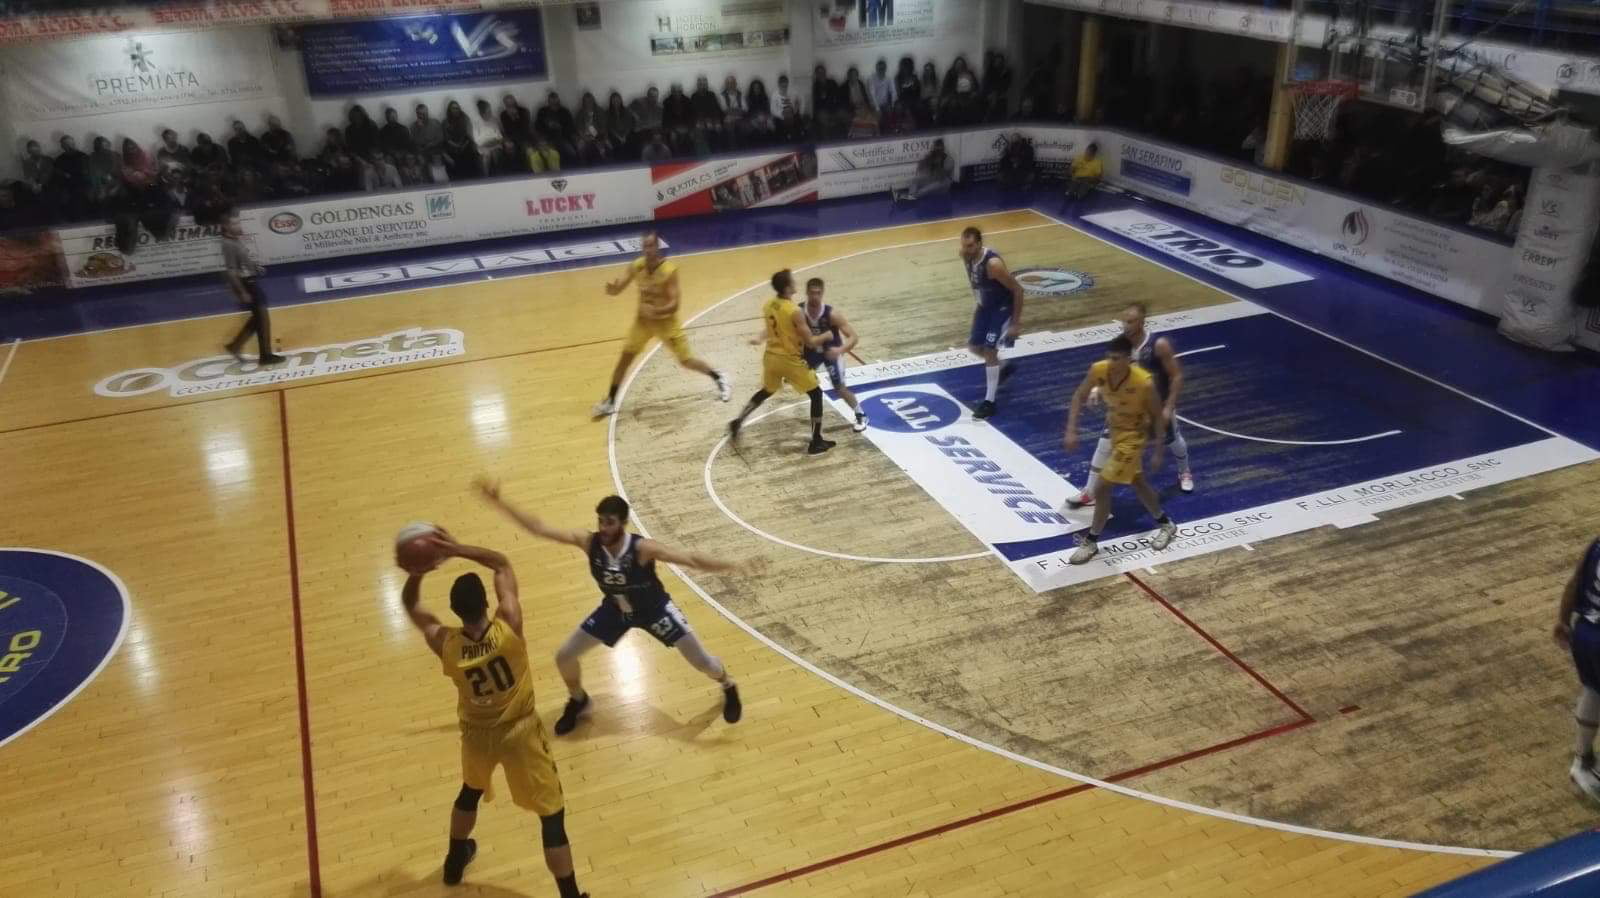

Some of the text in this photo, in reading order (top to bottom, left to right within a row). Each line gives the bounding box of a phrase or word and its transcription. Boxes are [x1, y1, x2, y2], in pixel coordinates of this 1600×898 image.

[96, 71, 200, 95] PREMIATA
[902, 140, 932, 153] ROM
[1120, 143, 1183, 171] SAN SERAFINO
[1220, 166, 1305, 206] GOLDEN
[310, 202, 414, 225] GOLDENGAS
[526, 193, 596, 216] LUCKY
[302, 219, 428, 242] STAZIONE DI SERVIZIO
[1150, 230, 1264, 268] TRIO
[175, 345, 458, 396] costruzioni meccaniche
[875, 352, 968, 373] MORLACCO
[880, 396, 941, 430] ALL
[923, 434, 1072, 525] SERVICE
[1296, 457, 1502, 512] F.LLI MORLACCO SNC
[1103, 521, 1224, 555] MORCCO
[1234, 511, 1273, 526] SNC
[1180, 529, 1248, 550] CALZATURE
[602, 570, 627, 585] 23
[651, 616, 674, 636] 23
[463, 655, 516, 697] 20
